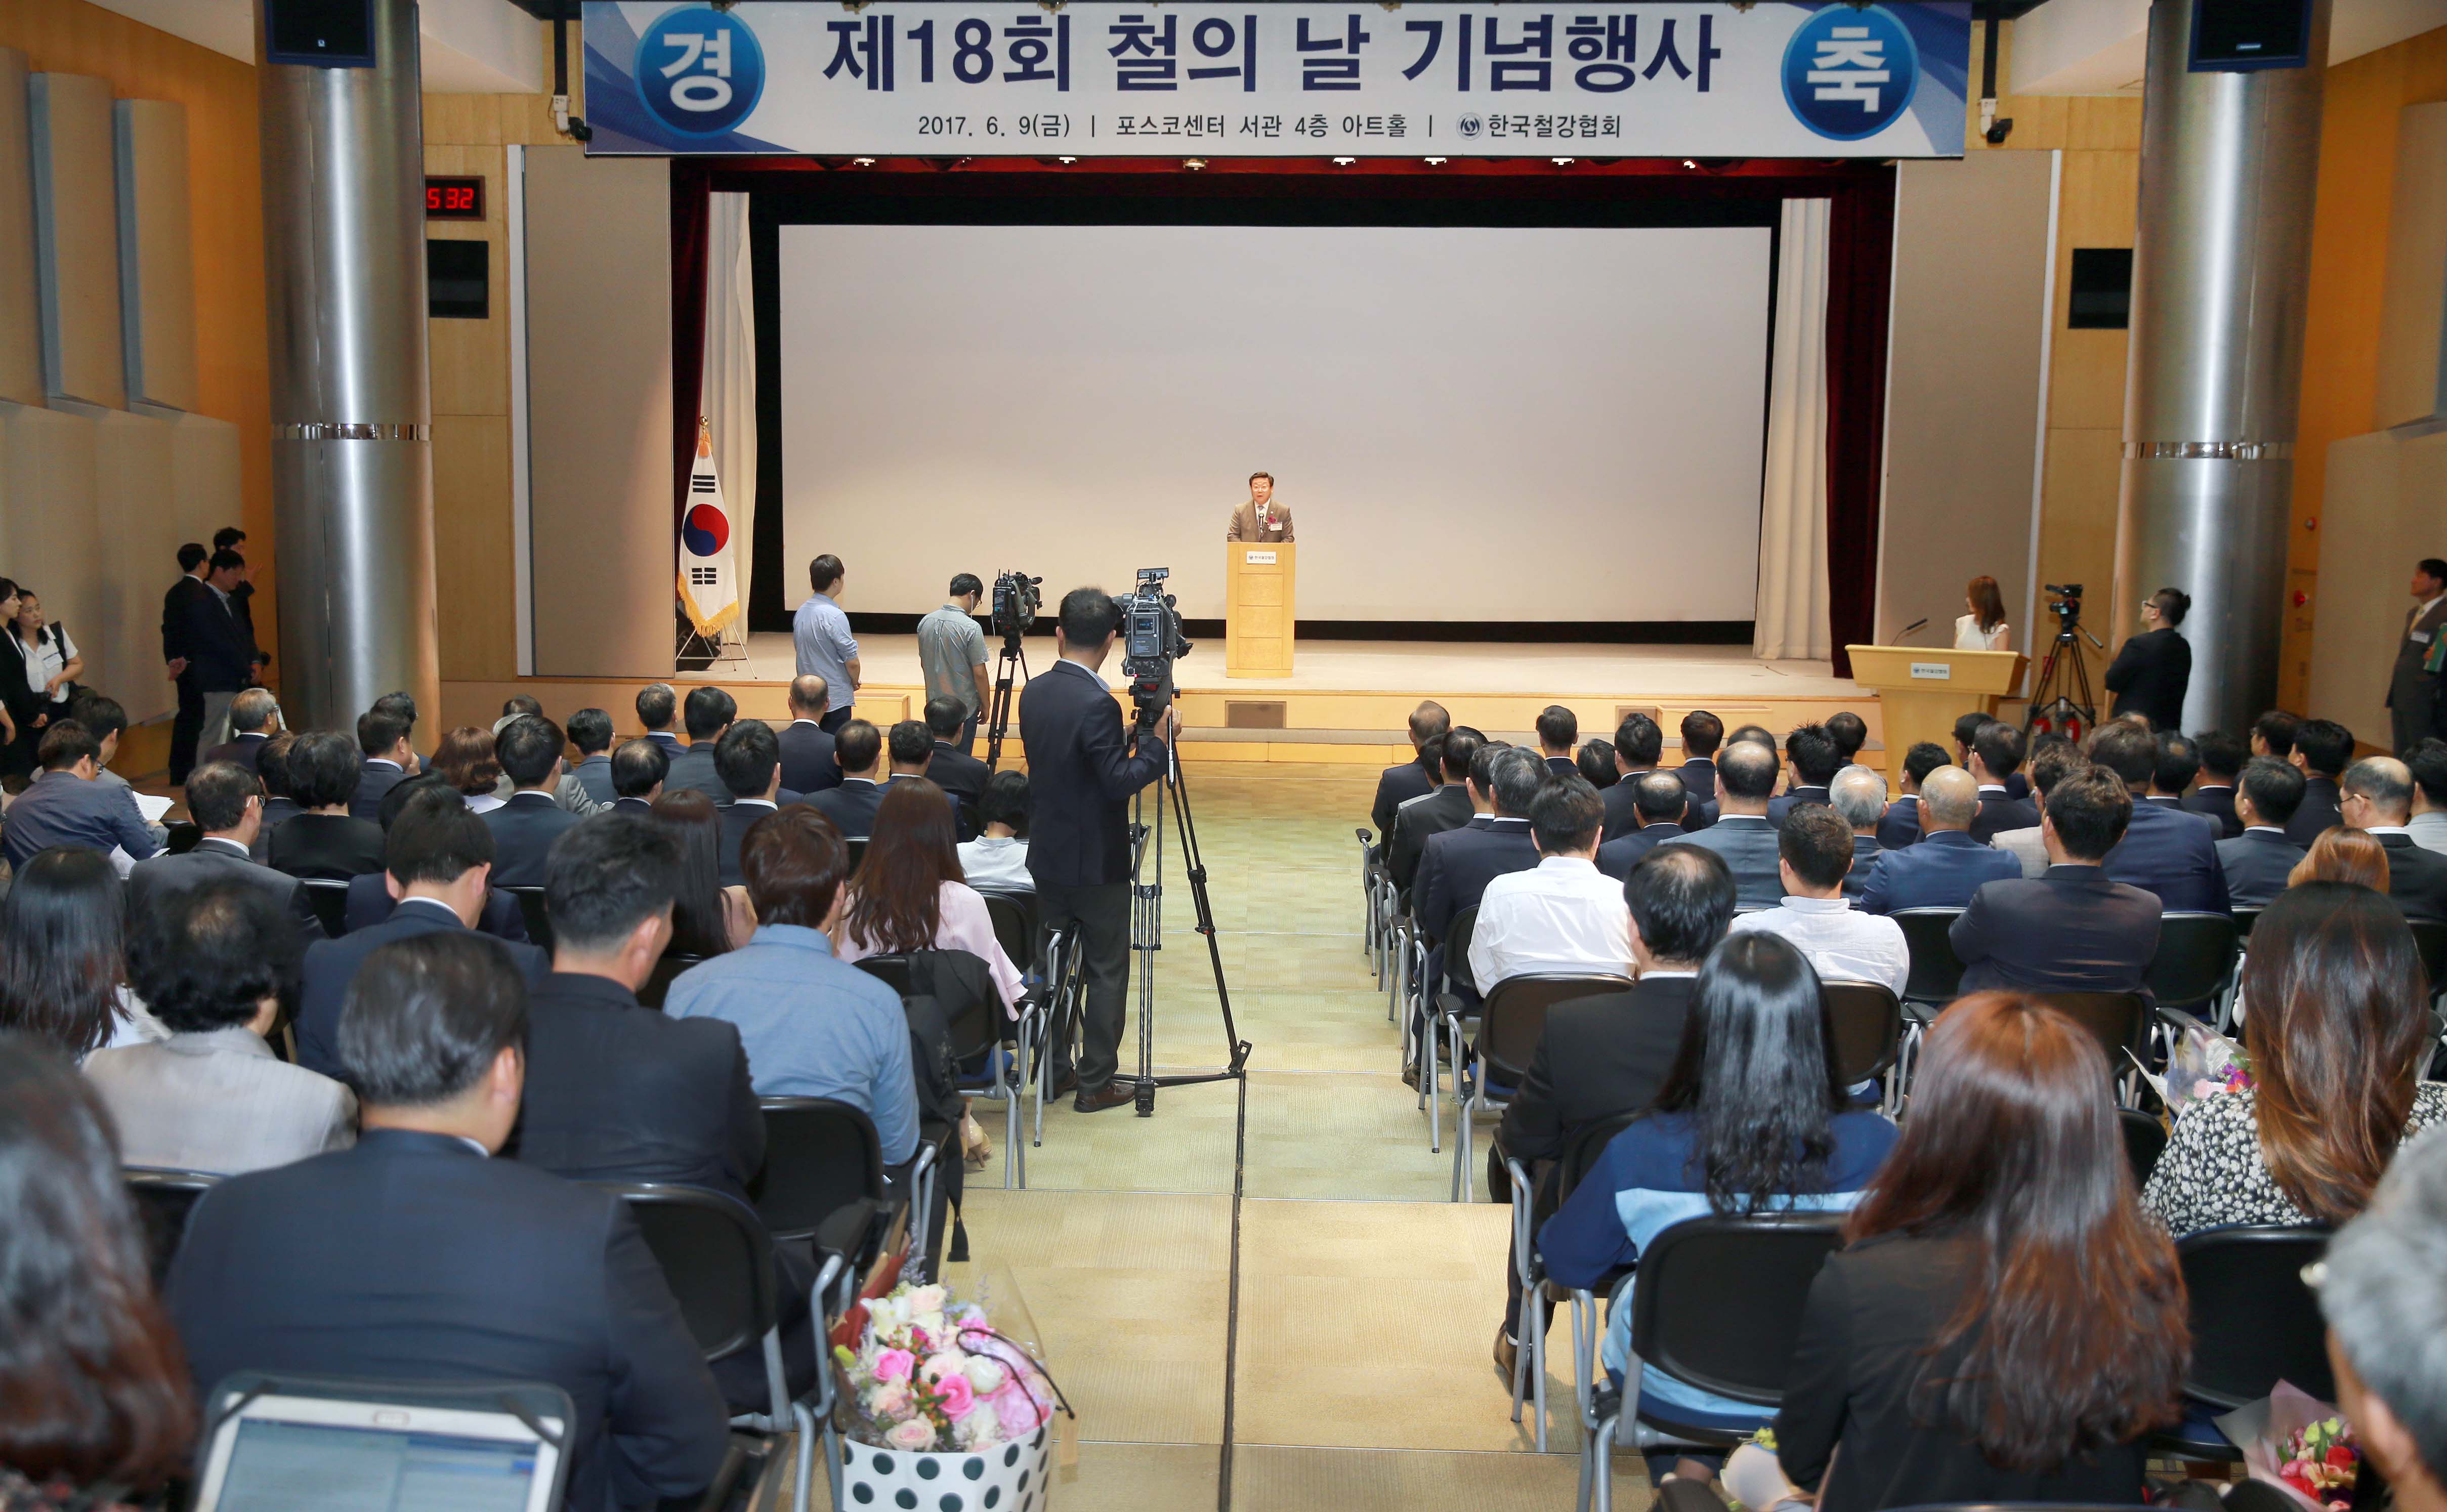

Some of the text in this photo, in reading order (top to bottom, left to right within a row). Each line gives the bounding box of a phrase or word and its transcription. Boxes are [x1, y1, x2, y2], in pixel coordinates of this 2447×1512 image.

[659, 28, 733, 112] 경
[822, 13, 1721, 94] 제18회 철의 날 기념행사
[1804, 26, 1891, 112] 축
[918, 113, 1621, 139] 2017. 6. 9(금) 포스코센터 서관 4층 아트홀 한국철강협회
